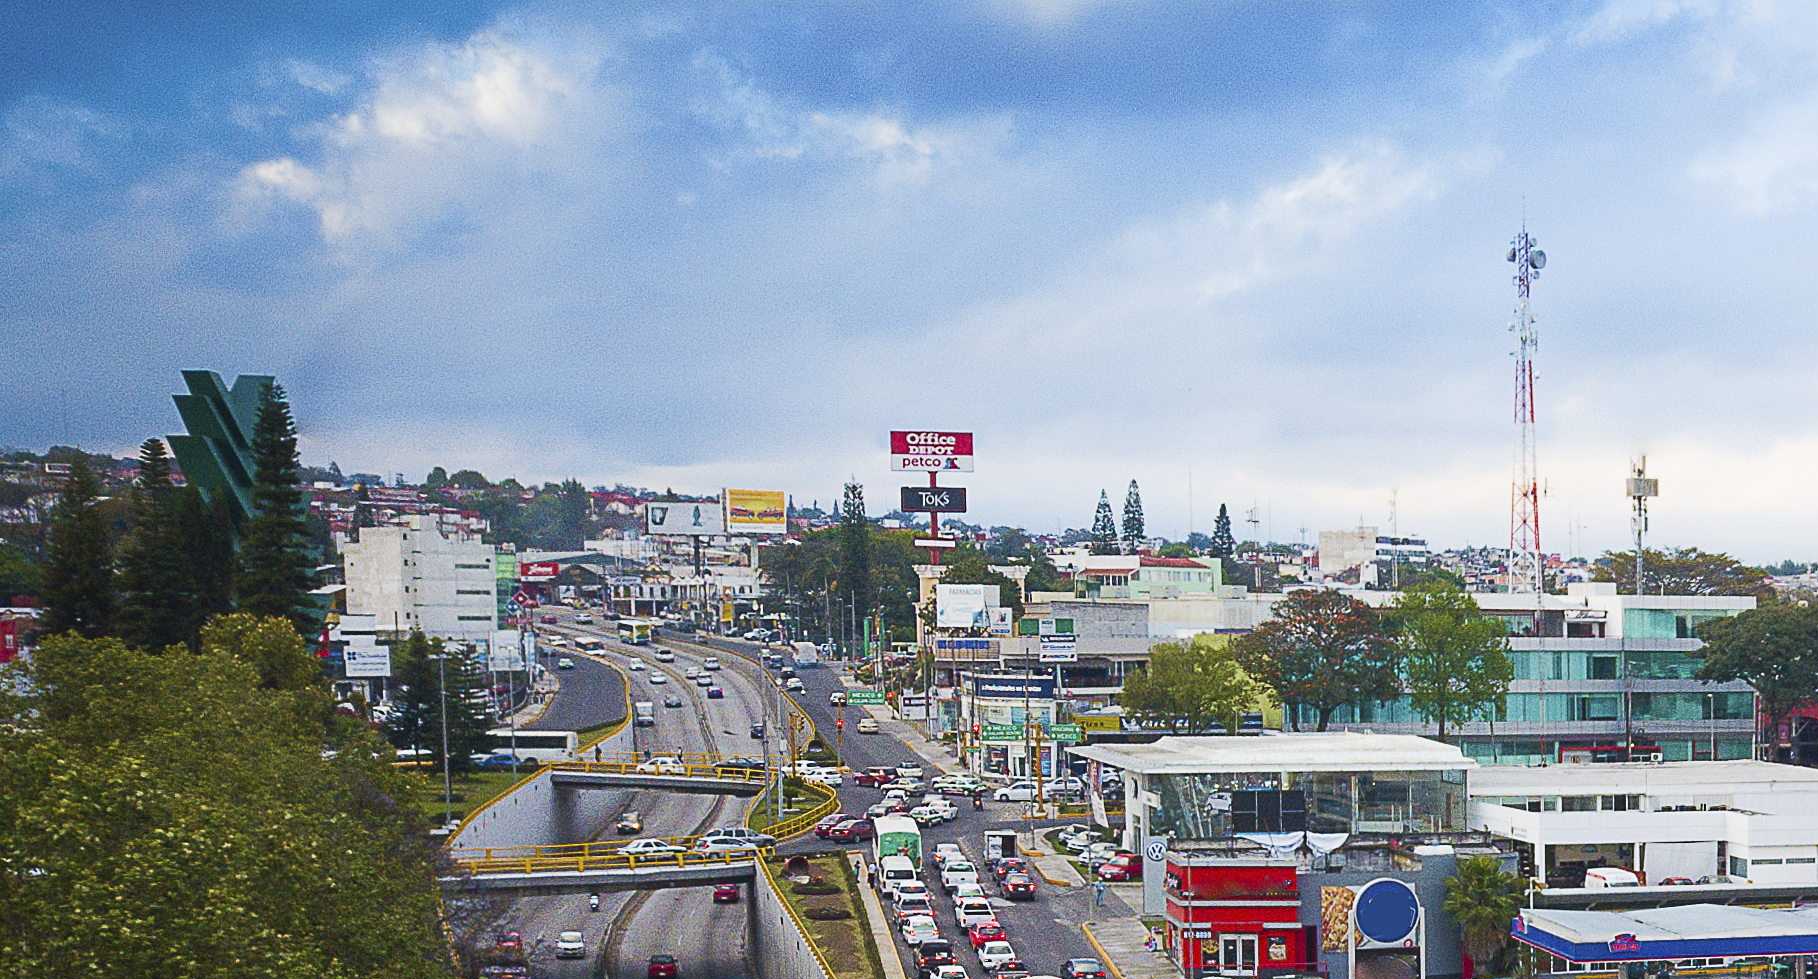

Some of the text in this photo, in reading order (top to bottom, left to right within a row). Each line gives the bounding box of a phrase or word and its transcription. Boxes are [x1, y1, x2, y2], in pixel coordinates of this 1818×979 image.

[906, 433, 956, 445] Office
[908, 446, 955, 455] DEPOT
[902, 457, 941, 468] petco
[949, 588, 982, 596] FARMACIAS
